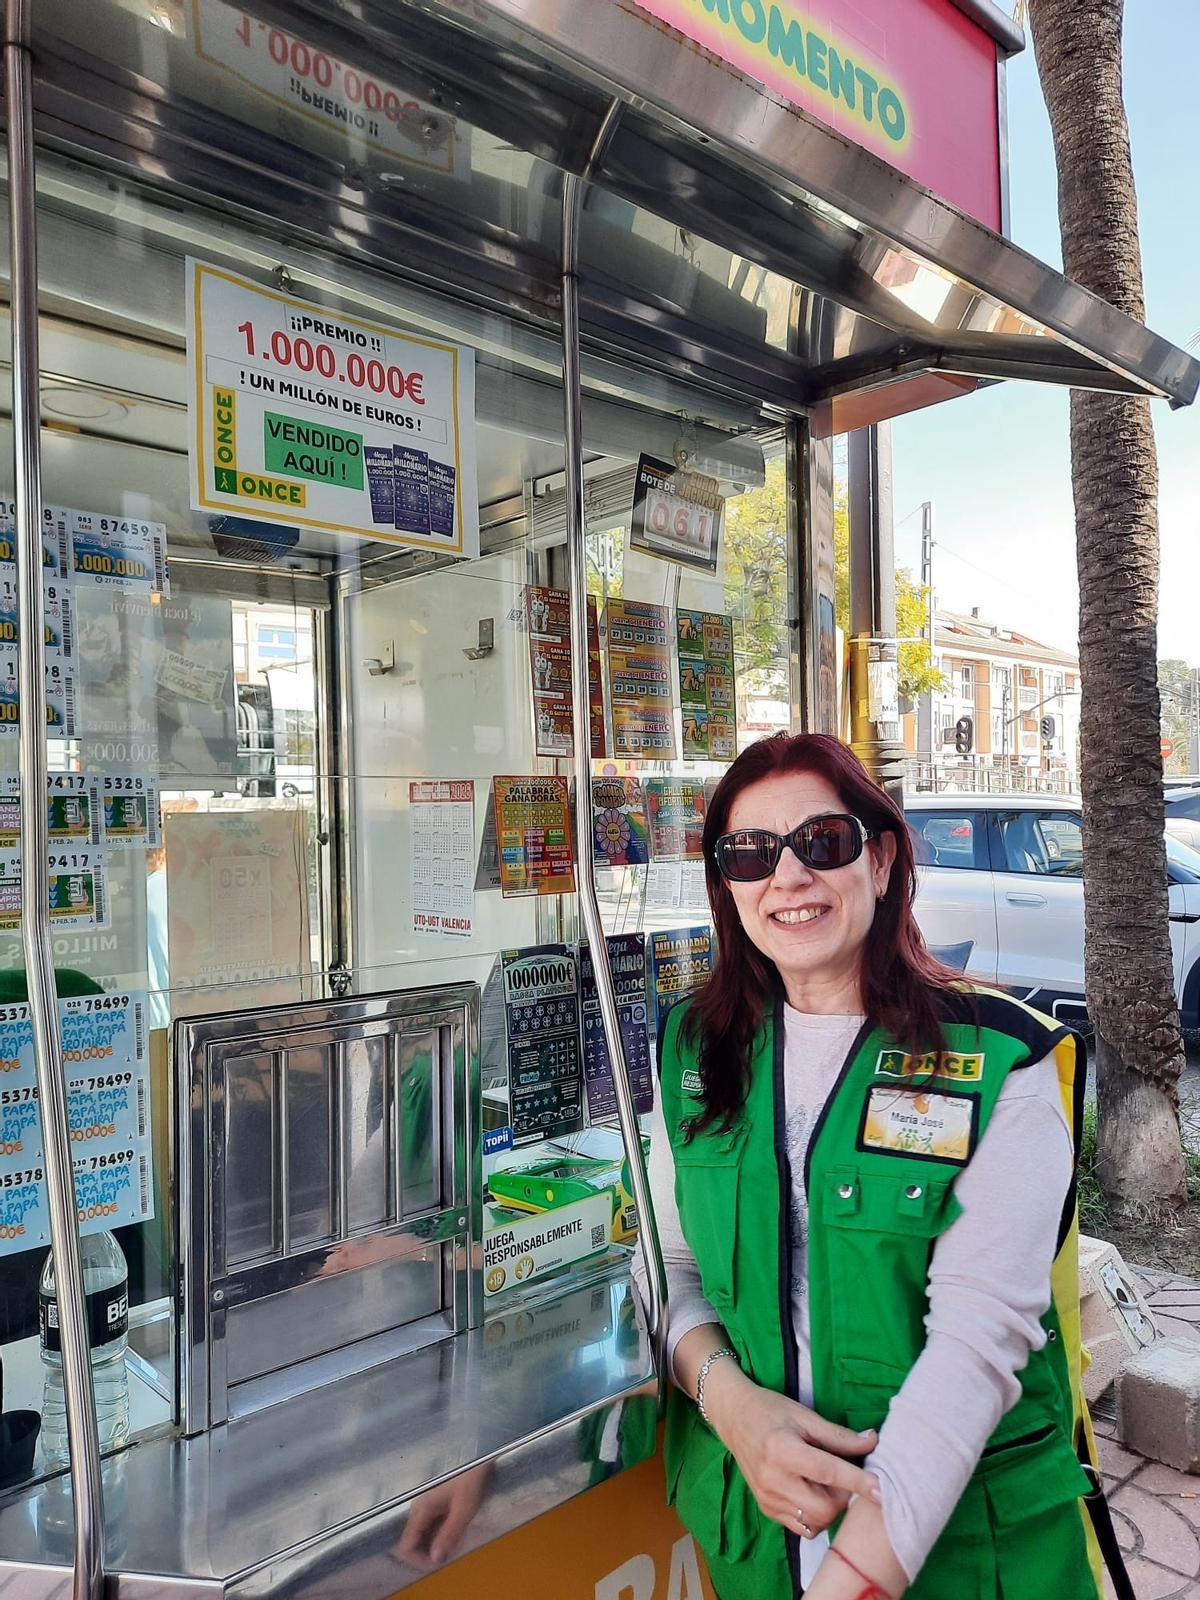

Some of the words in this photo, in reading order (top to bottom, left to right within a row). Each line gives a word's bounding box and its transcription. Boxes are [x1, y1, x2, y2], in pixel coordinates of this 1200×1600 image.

[238, 320, 426, 405] 1.000.000€
[250, 373, 275, 393] UN
[279, 382, 339, 411] MILLÓN
[342, 399, 362, 416] DE
[365, 405, 414, 432] EUROS
[216, 391, 234, 465] ONCE
[267, 418, 361, 458] VENDIDO
[283, 450, 336, 479] AQUÍ
[241, 476, 302, 504] ONCE
[641, 472, 664, 490] BOTE
[664, 480, 676, 494] DE
[100, 519, 149, 537] 87459
[104, 777, 143, 789] 5328
[509, 786, 555, 796] PALABRAS
[504, 794, 561, 803] GANADORAS
[48, 853, 89, 869] 9417
[441, 916, 472, 931] VALENCIA
[655, 936, 710, 959] MILLONARIO
[658, 957, 710, 978] 500.000€
[85, 995, 130, 1013] 78499
[87, 1072, 132, 1091] 78499
[90, 1149, 134, 1170] 78499
[75, 1169, 98, 1185] APÁ,
[484, 1230, 515, 1253] JUEGA
[484, 1218, 583, 1268] RESPONSABLEMENTE
